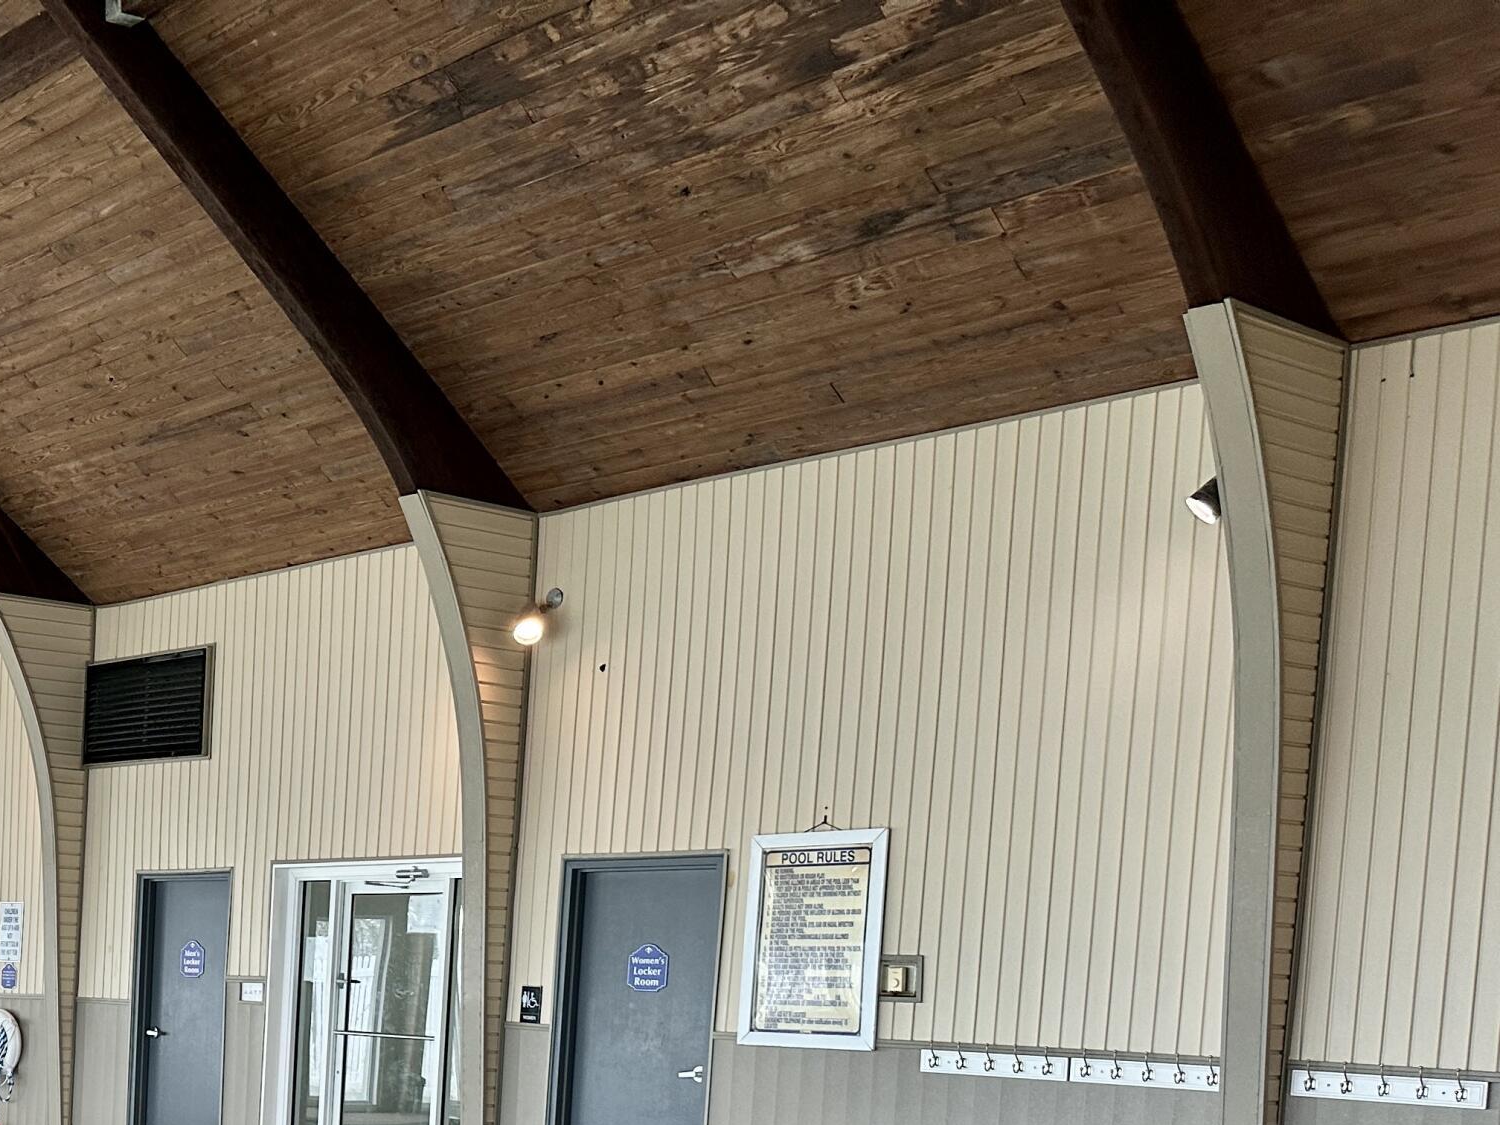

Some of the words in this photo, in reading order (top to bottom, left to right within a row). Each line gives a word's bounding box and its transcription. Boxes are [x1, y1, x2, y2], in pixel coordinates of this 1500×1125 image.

[781, 852, 813, 865] POOL
[816, 850, 856, 863] RULES
[631, 956, 665, 965] Women's
[633, 966, 662, 976] Locker
[634, 977, 659, 986] Room
